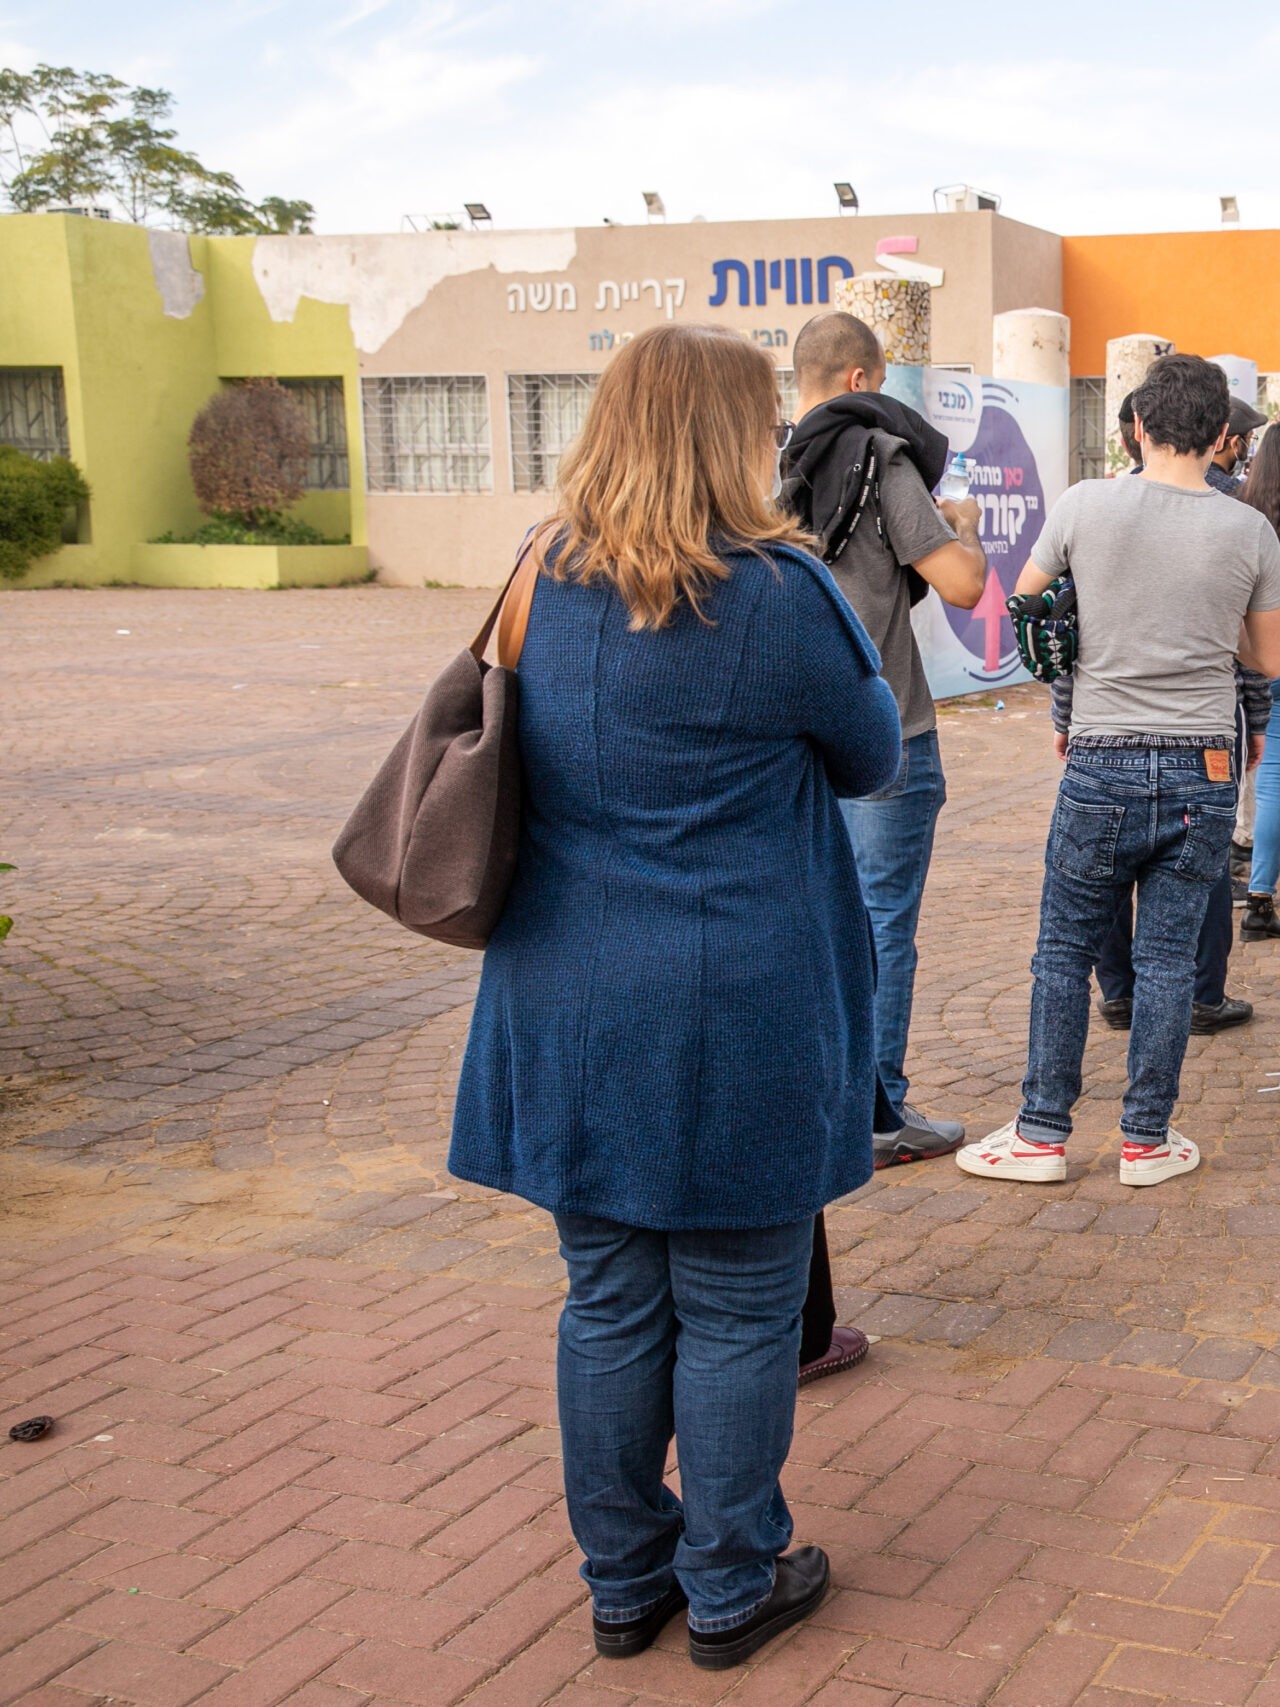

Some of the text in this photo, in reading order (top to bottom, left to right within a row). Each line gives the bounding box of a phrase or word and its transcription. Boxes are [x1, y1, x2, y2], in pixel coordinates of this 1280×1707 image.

[506, 255, 855, 320] חוויות קריית משה
[938, 391, 967, 410] מכבי
[966, 465, 1024, 491] כאן מתחס
[974, 493, 1026, 546] קורו
